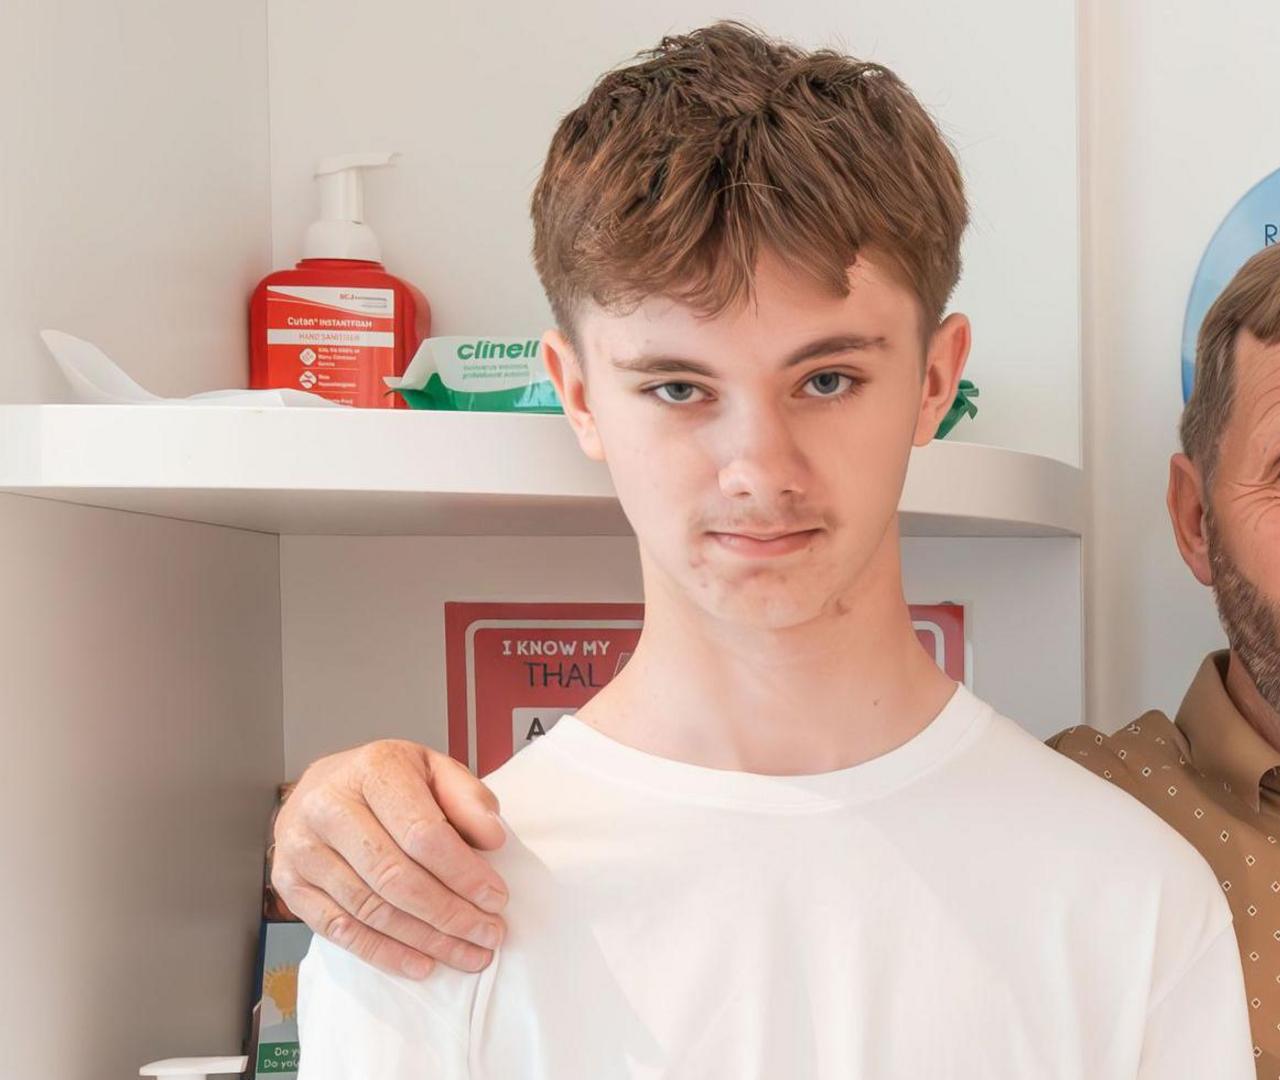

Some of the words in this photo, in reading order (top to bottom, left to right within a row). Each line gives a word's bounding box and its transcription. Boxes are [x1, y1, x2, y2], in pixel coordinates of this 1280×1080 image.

[457, 340, 540, 360] clinell
[502, 640, 512, 656] I
[517, 640, 577, 656] KNOW
[583, 641, 610, 656] MY
[263, 1058, 278, 1069] Do
